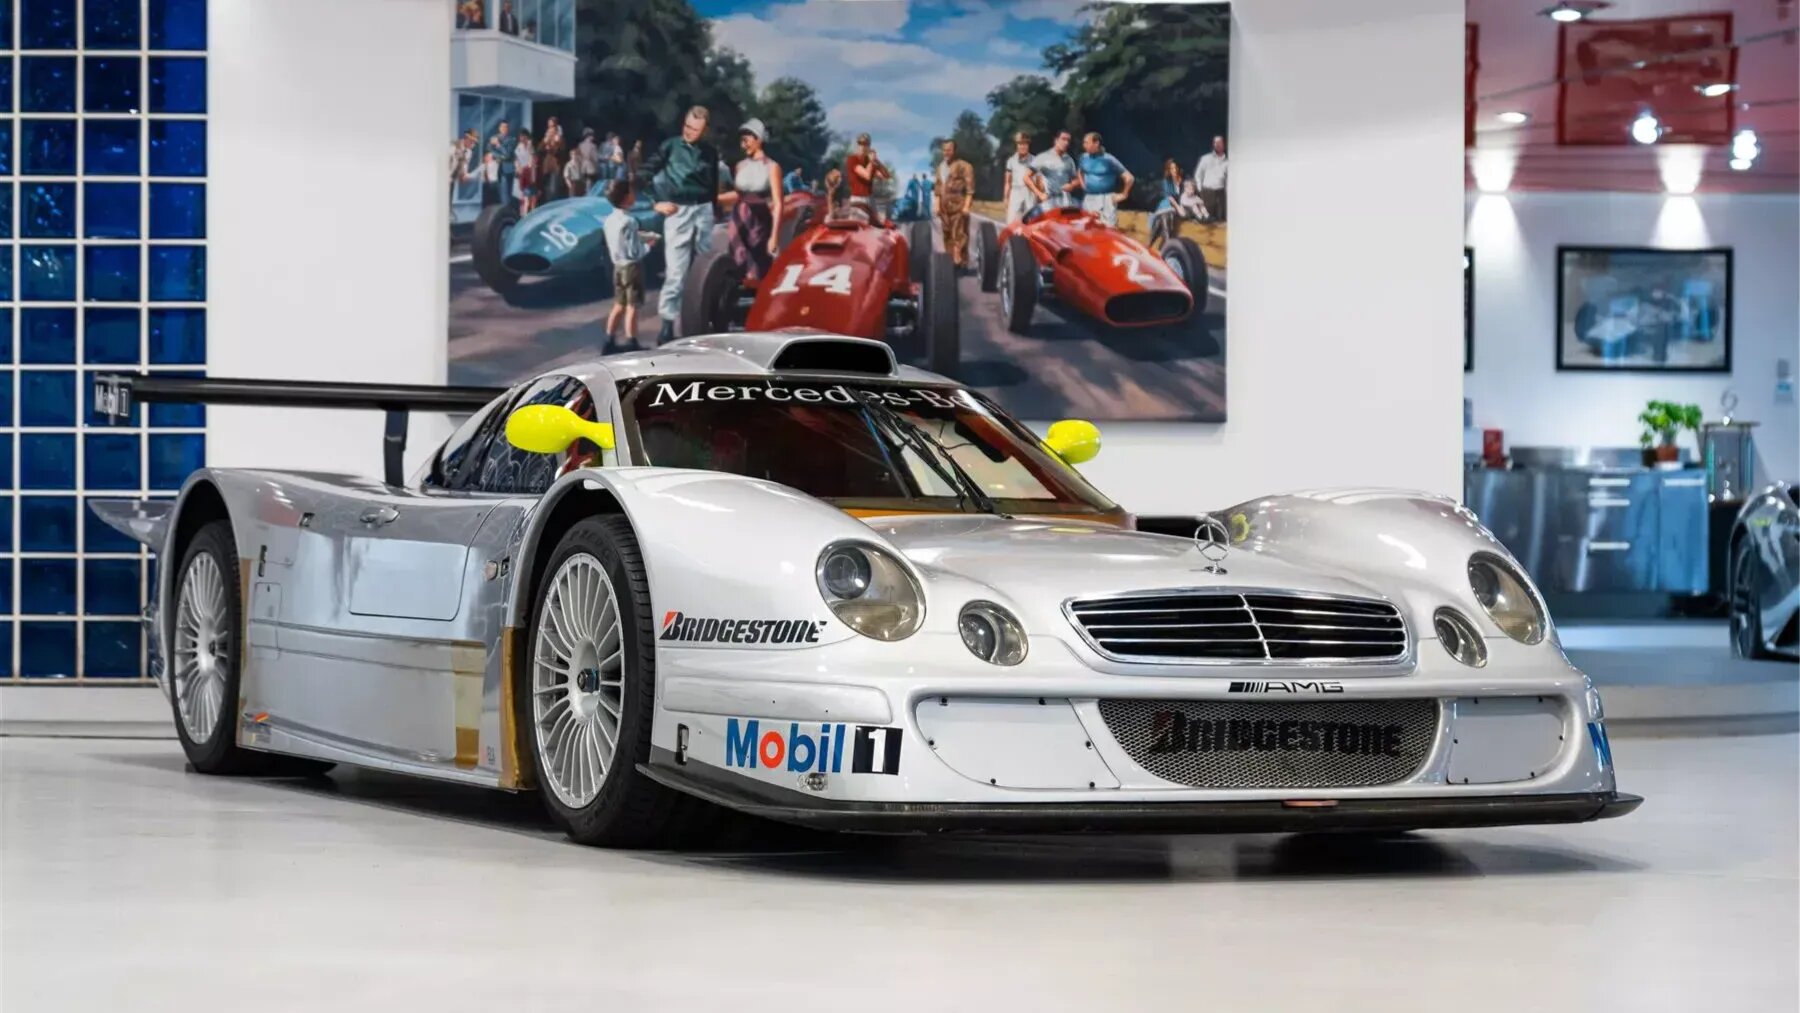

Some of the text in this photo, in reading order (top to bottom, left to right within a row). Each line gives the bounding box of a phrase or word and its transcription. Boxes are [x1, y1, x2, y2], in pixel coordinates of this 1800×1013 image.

[540, 223, 578, 250] 18
[769, 264, 852, 296] 14
[659, 611, 828, 644] BRIDGESTONE
[1264, 681, 1345, 694] AMG
[725, 718, 888, 774] Mobil 1
[1150, 710, 1401, 757] BRIDGESTONE
